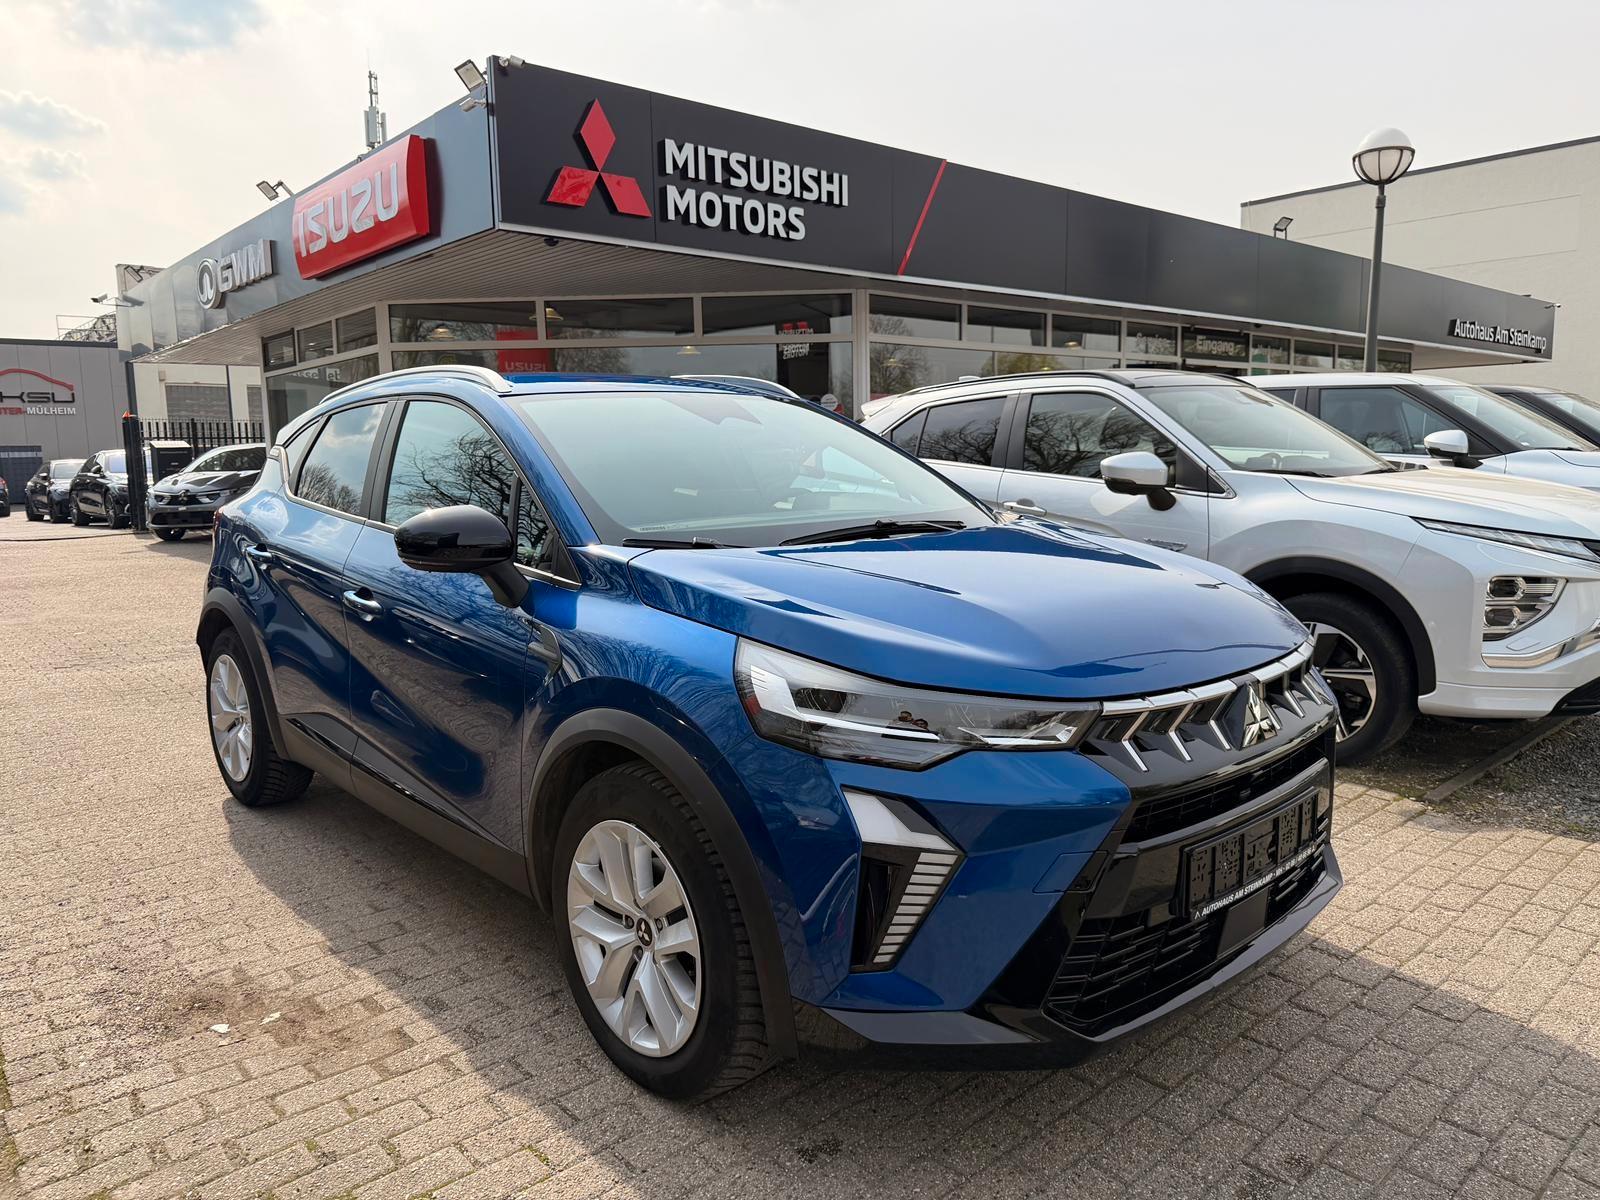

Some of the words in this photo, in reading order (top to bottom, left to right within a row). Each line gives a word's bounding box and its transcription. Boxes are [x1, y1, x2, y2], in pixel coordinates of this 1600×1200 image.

[665, 138, 848, 206] MITSUBISHI
[299, 162, 398, 258] ISUZU
[667, 184, 806, 240] MOTORS
[218, 239, 270, 292] GWM
[1196, 335, 1234, 355] Eingang
[1454, 319, 1494, 341] Autohaus
[1494, 326, 1508, 343] Am
[1509, 328, 1547, 354] Steinkamp
[1202, 894, 1234, 916] AUTOHAUS
[1234, 888, 1245, 901] AM
